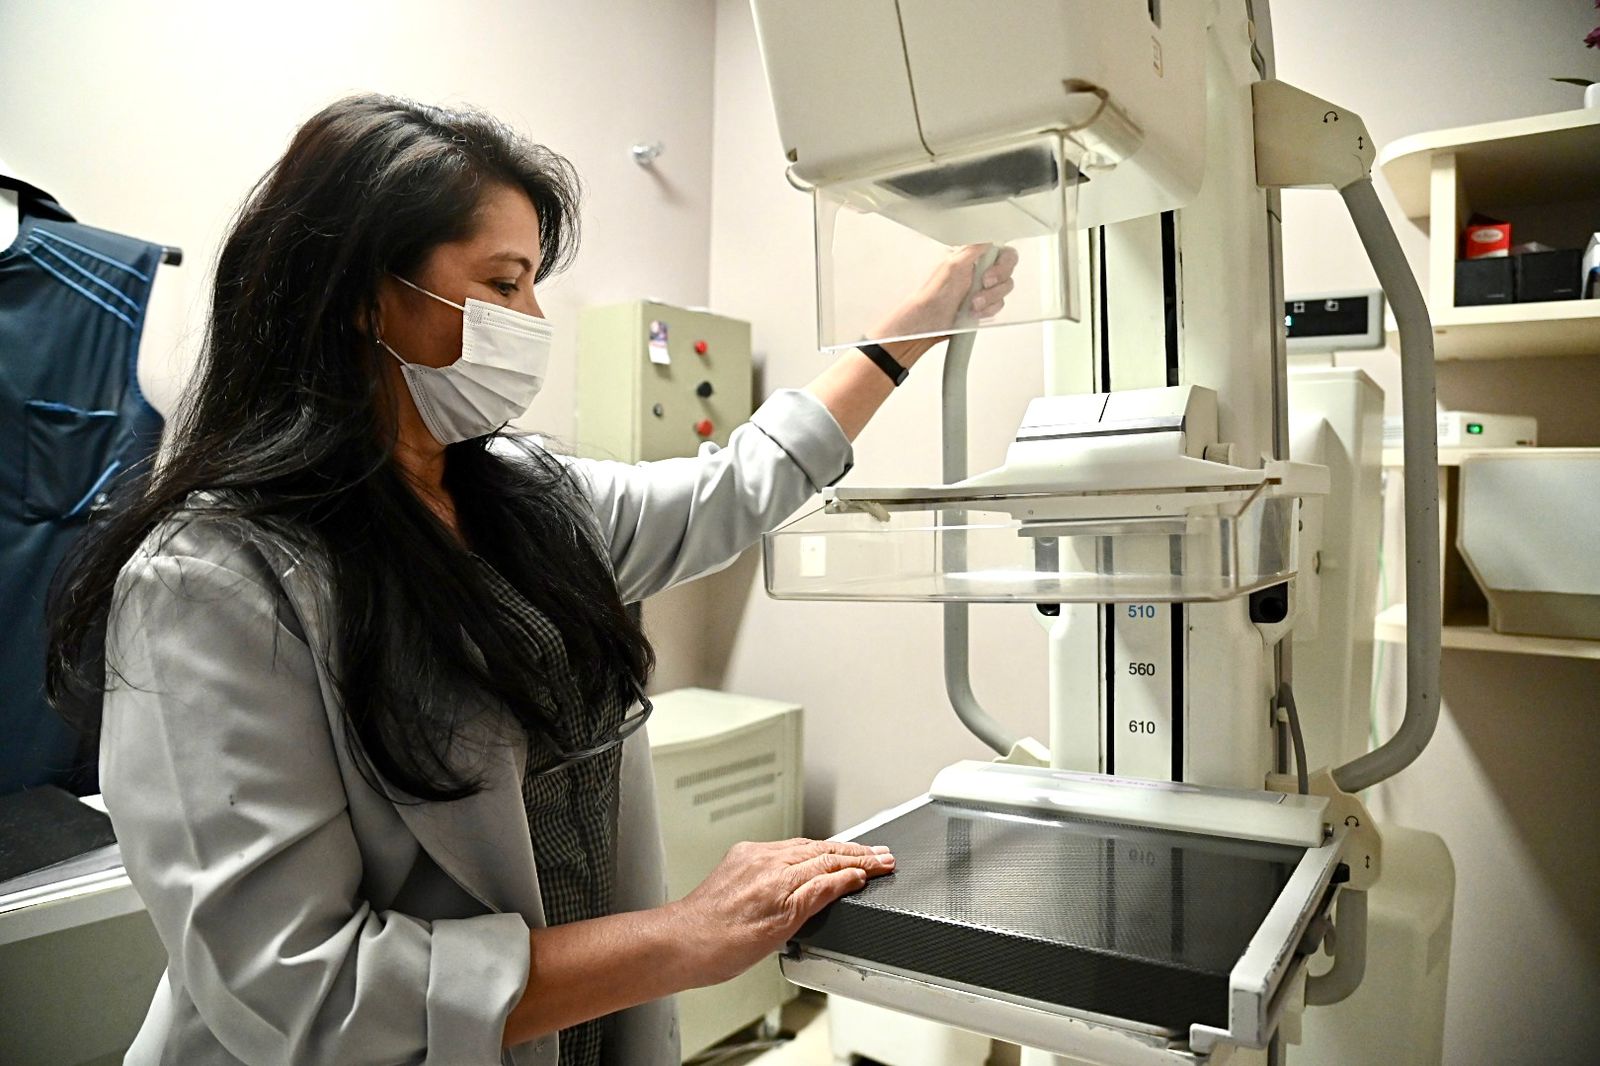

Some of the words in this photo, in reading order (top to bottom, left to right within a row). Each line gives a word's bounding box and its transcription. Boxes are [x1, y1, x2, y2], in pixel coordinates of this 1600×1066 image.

[1128, 605, 1155, 618] 510
[1128, 662, 1156, 676] 560
[1129, 720, 1156, 734] 610
